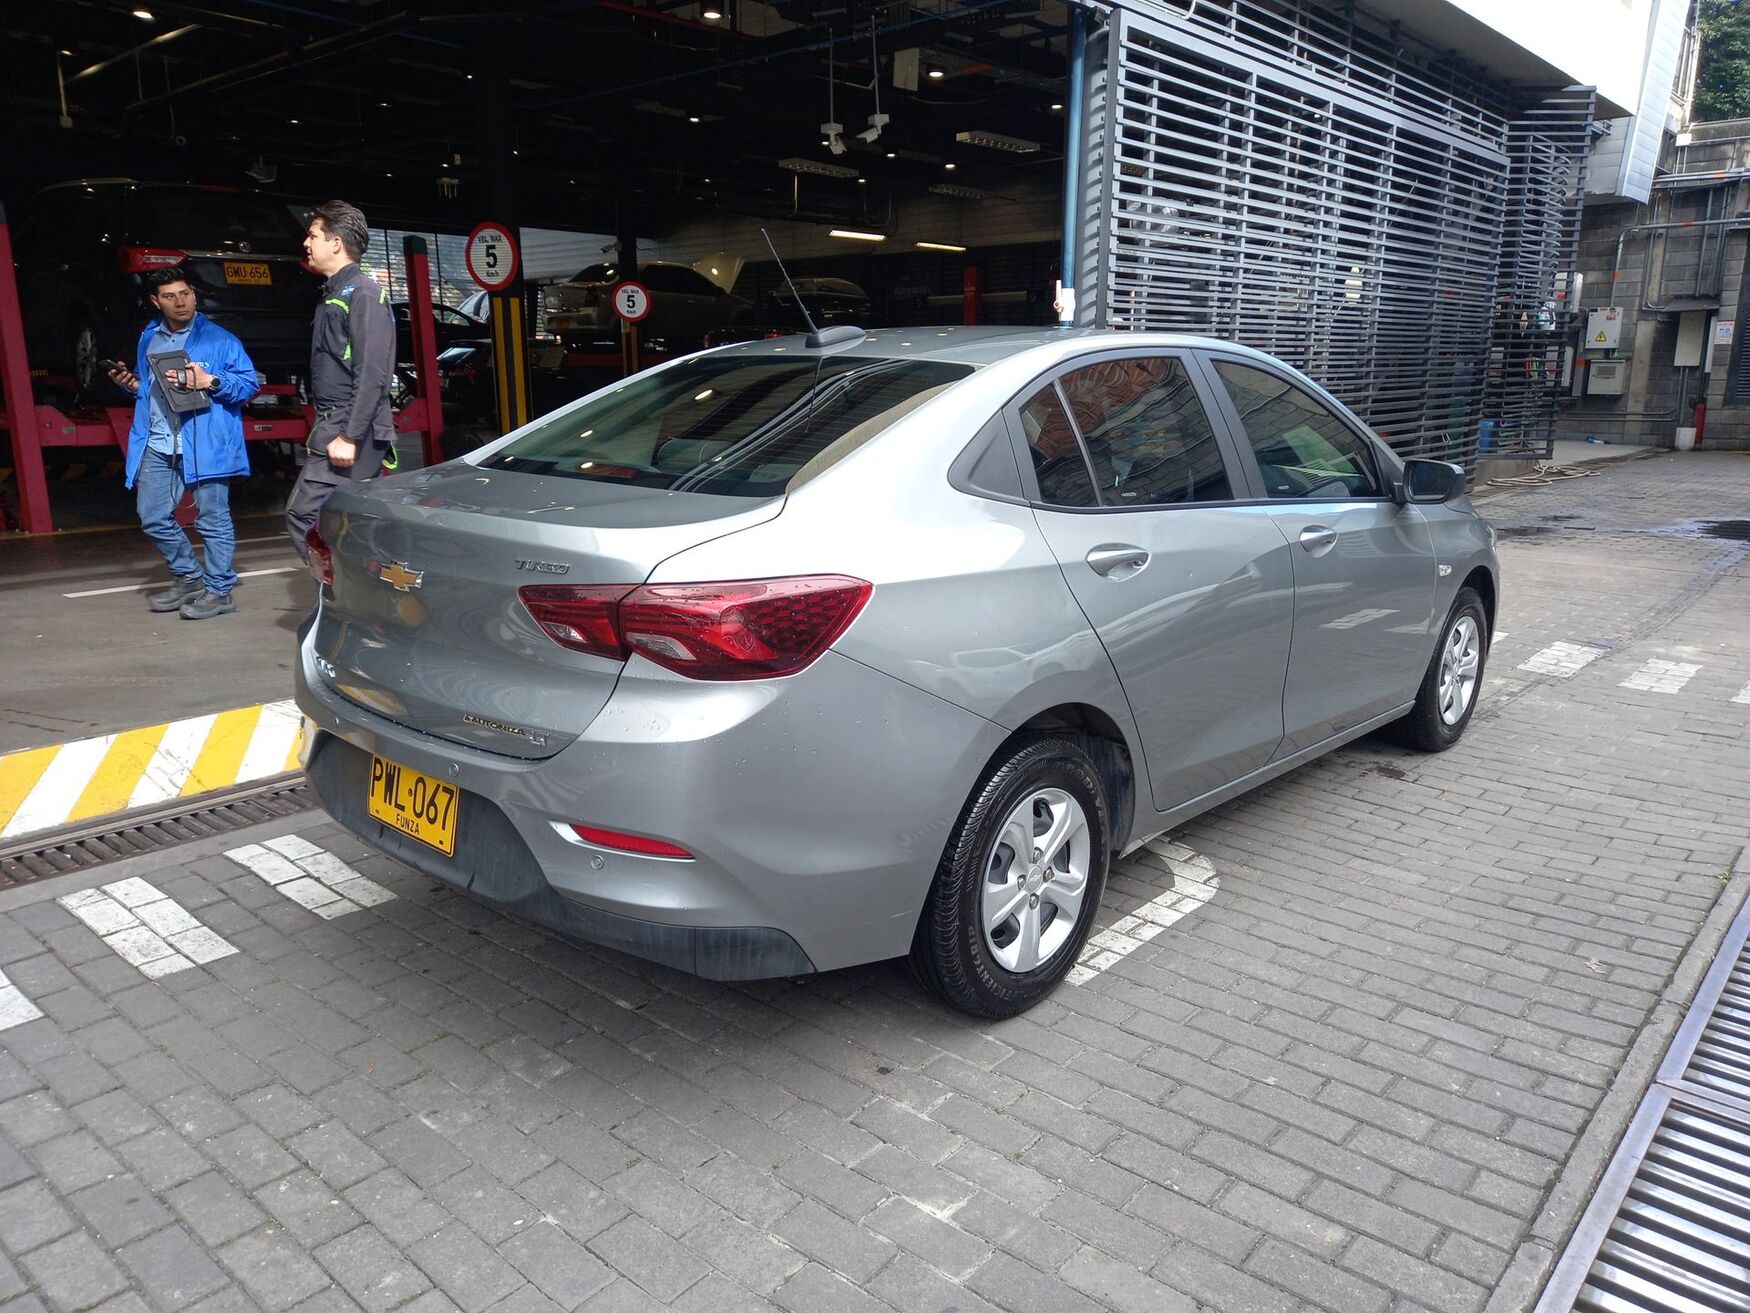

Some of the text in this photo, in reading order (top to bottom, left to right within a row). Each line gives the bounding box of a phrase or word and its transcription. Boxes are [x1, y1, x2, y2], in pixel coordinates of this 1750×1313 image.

[485, 244, 498, 269] 5
[226, 265, 270, 279] GMU 656
[626, 294, 636, 309] 5
[370, 756, 455, 832] PWL 067
[395, 813, 421, 836] FUNZA
